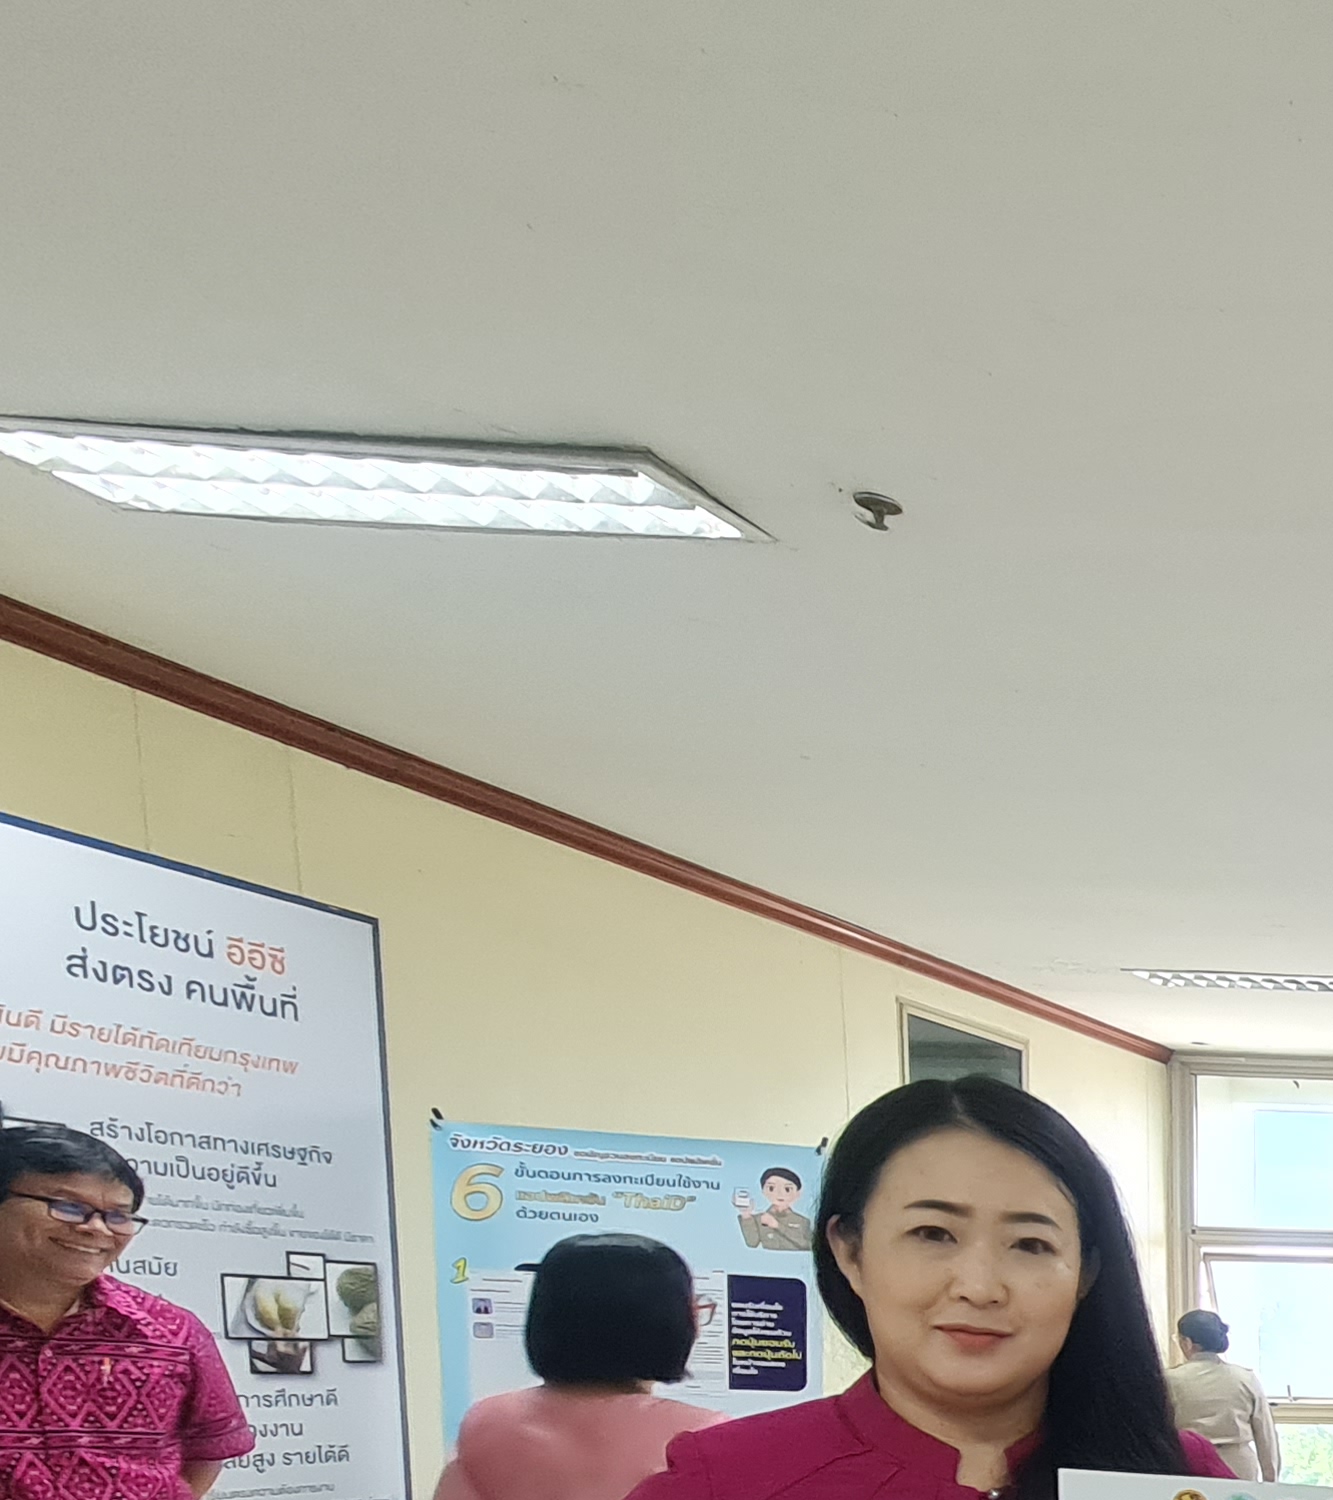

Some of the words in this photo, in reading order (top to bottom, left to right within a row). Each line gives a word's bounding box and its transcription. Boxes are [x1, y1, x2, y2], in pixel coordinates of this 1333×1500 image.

[74, 900, 214, 959] ประโยชน์
[226, 937, 286, 976] อีอีซี
[65, 946, 173, 997] ส่งตรง
[186, 974, 300, 1022] คนพื้นที่
[89, 1117, 333, 1167] สร้างโอกาสทางเศรษฐกิจ
[449, 1133, 569, 1157] จังหวัดระยอง
[126, 1155, 278, 1190] วามเป็นอยู่ดีขึ้น
[452, 1163, 504, 1222] 6
[515, 1160, 721, 1191] ขั้นตอนการลงทะเบียนใช้งาน
[516, 1206, 599, 1224] ด้วยตนเอง
[282, 1444, 350, 1466] รายได้ดี
